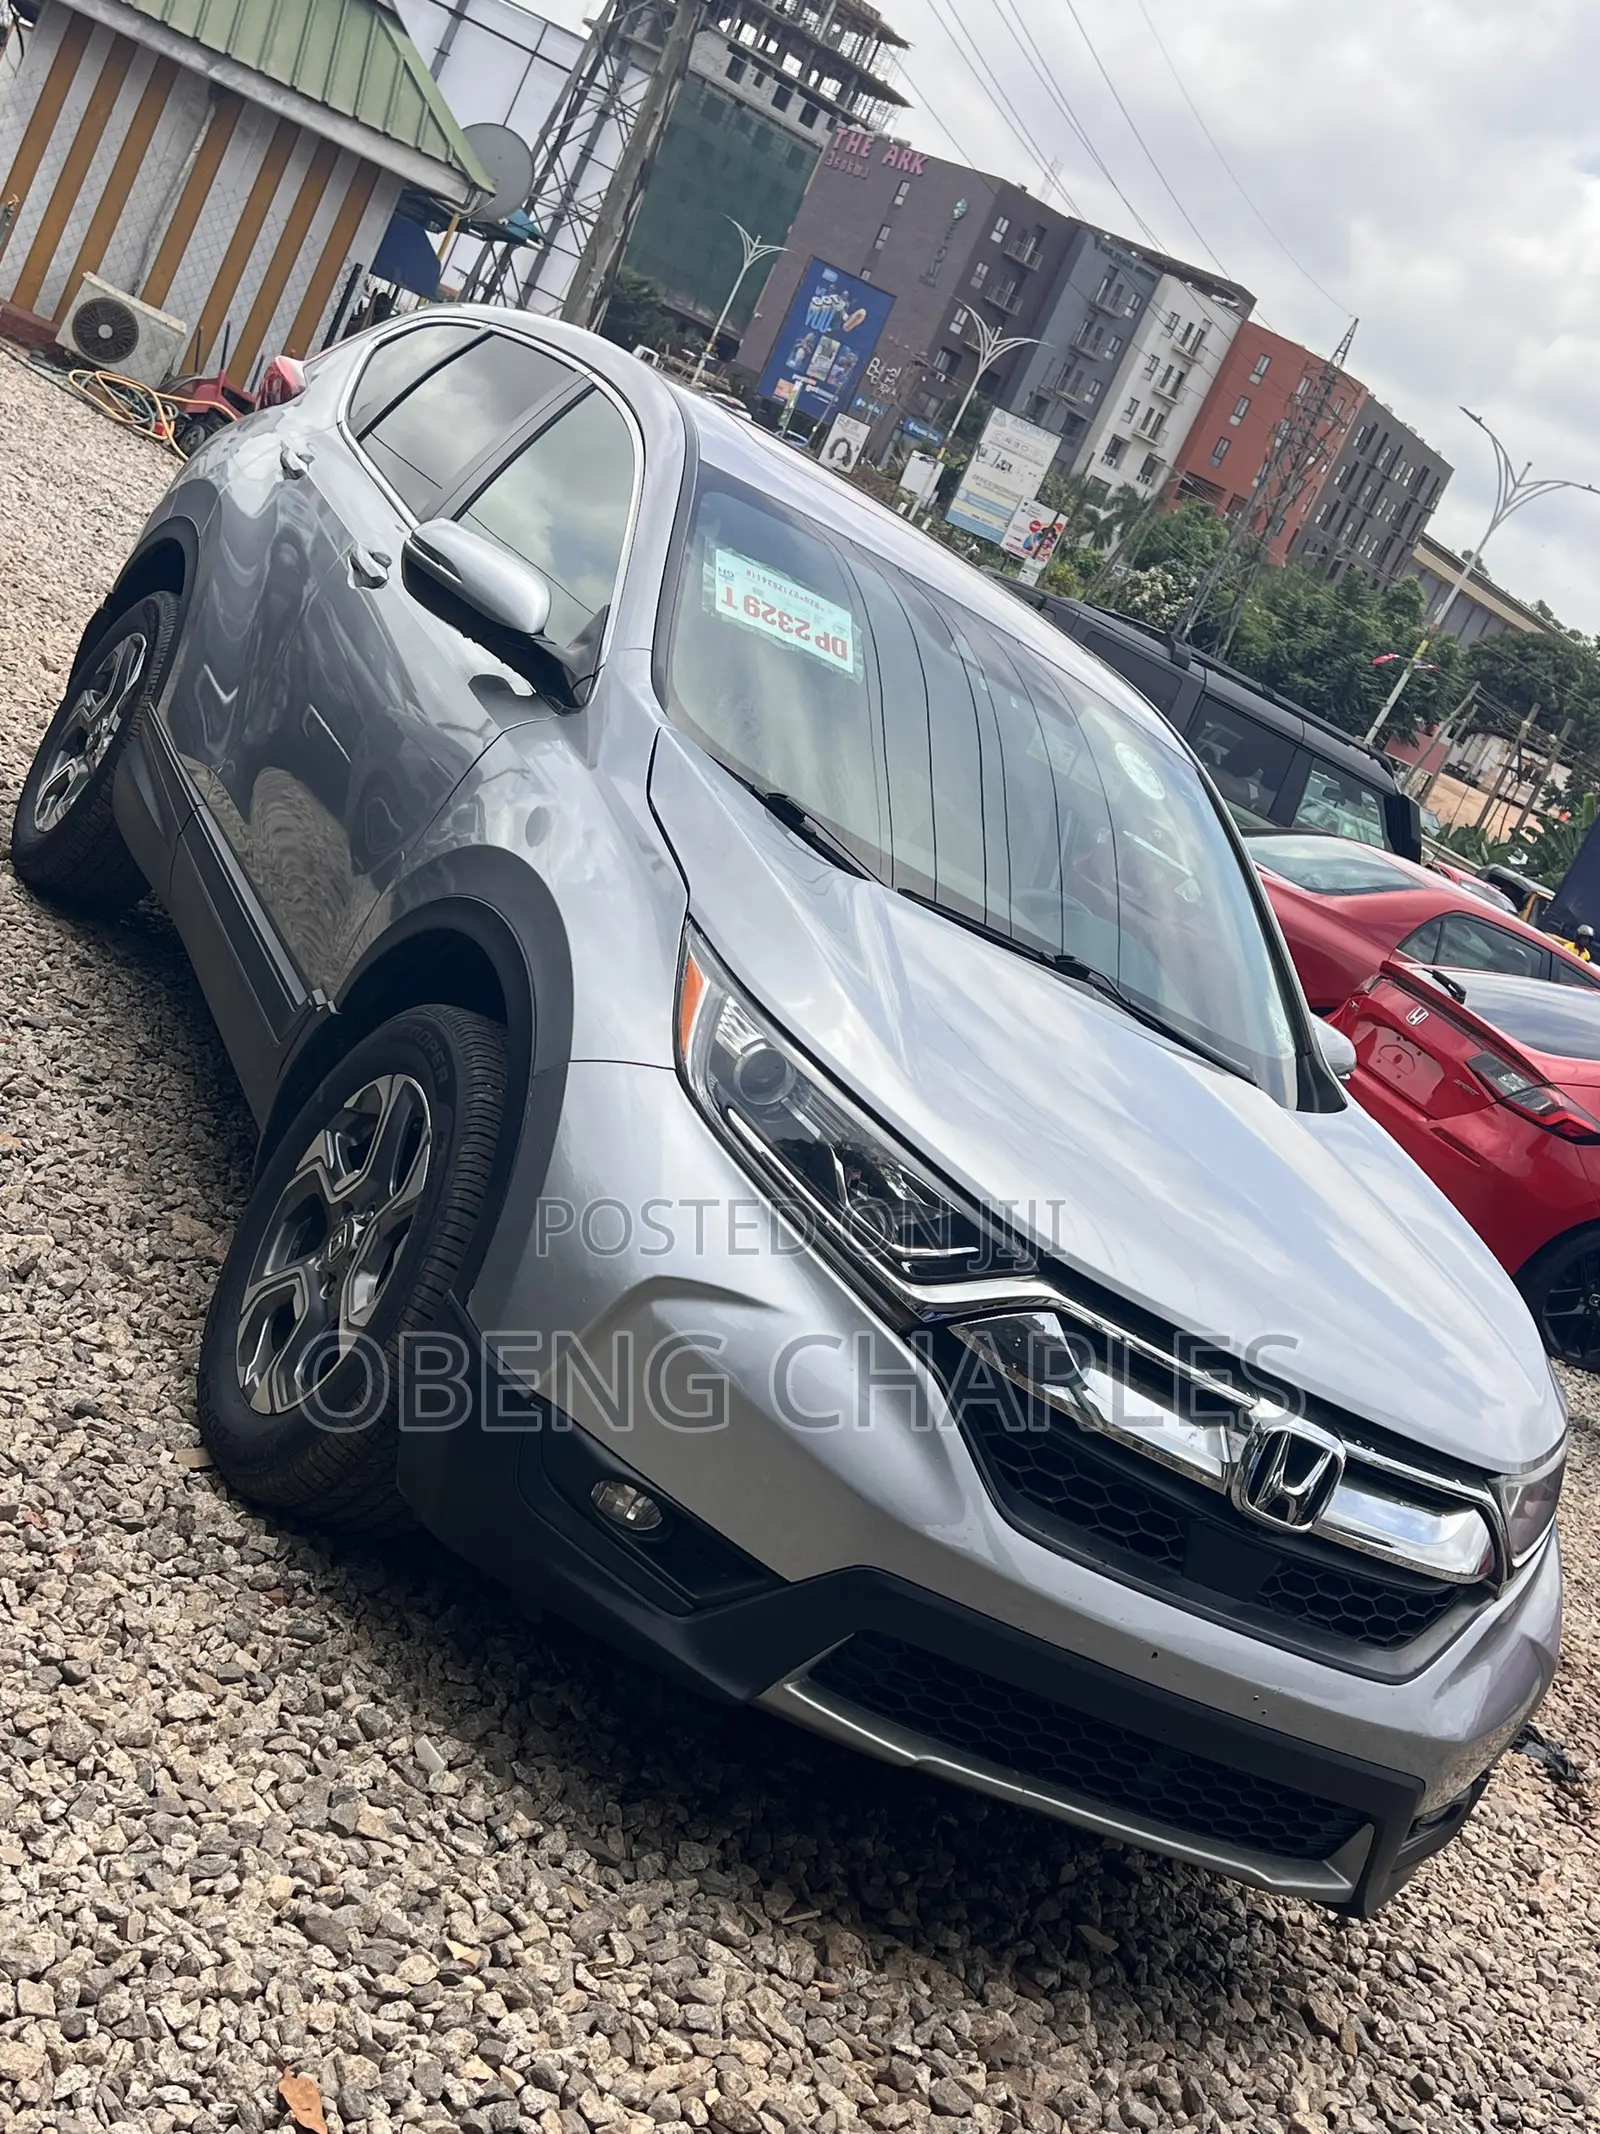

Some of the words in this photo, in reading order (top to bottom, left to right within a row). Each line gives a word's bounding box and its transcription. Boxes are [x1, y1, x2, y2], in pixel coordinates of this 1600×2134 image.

[833, 127, 874, 158] THE
[882, 144, 929, 175] ARK
[721, 586, 738, 610] T
[743, 594, 811, 641] 2329
[815, 631, 848, 661] DP
